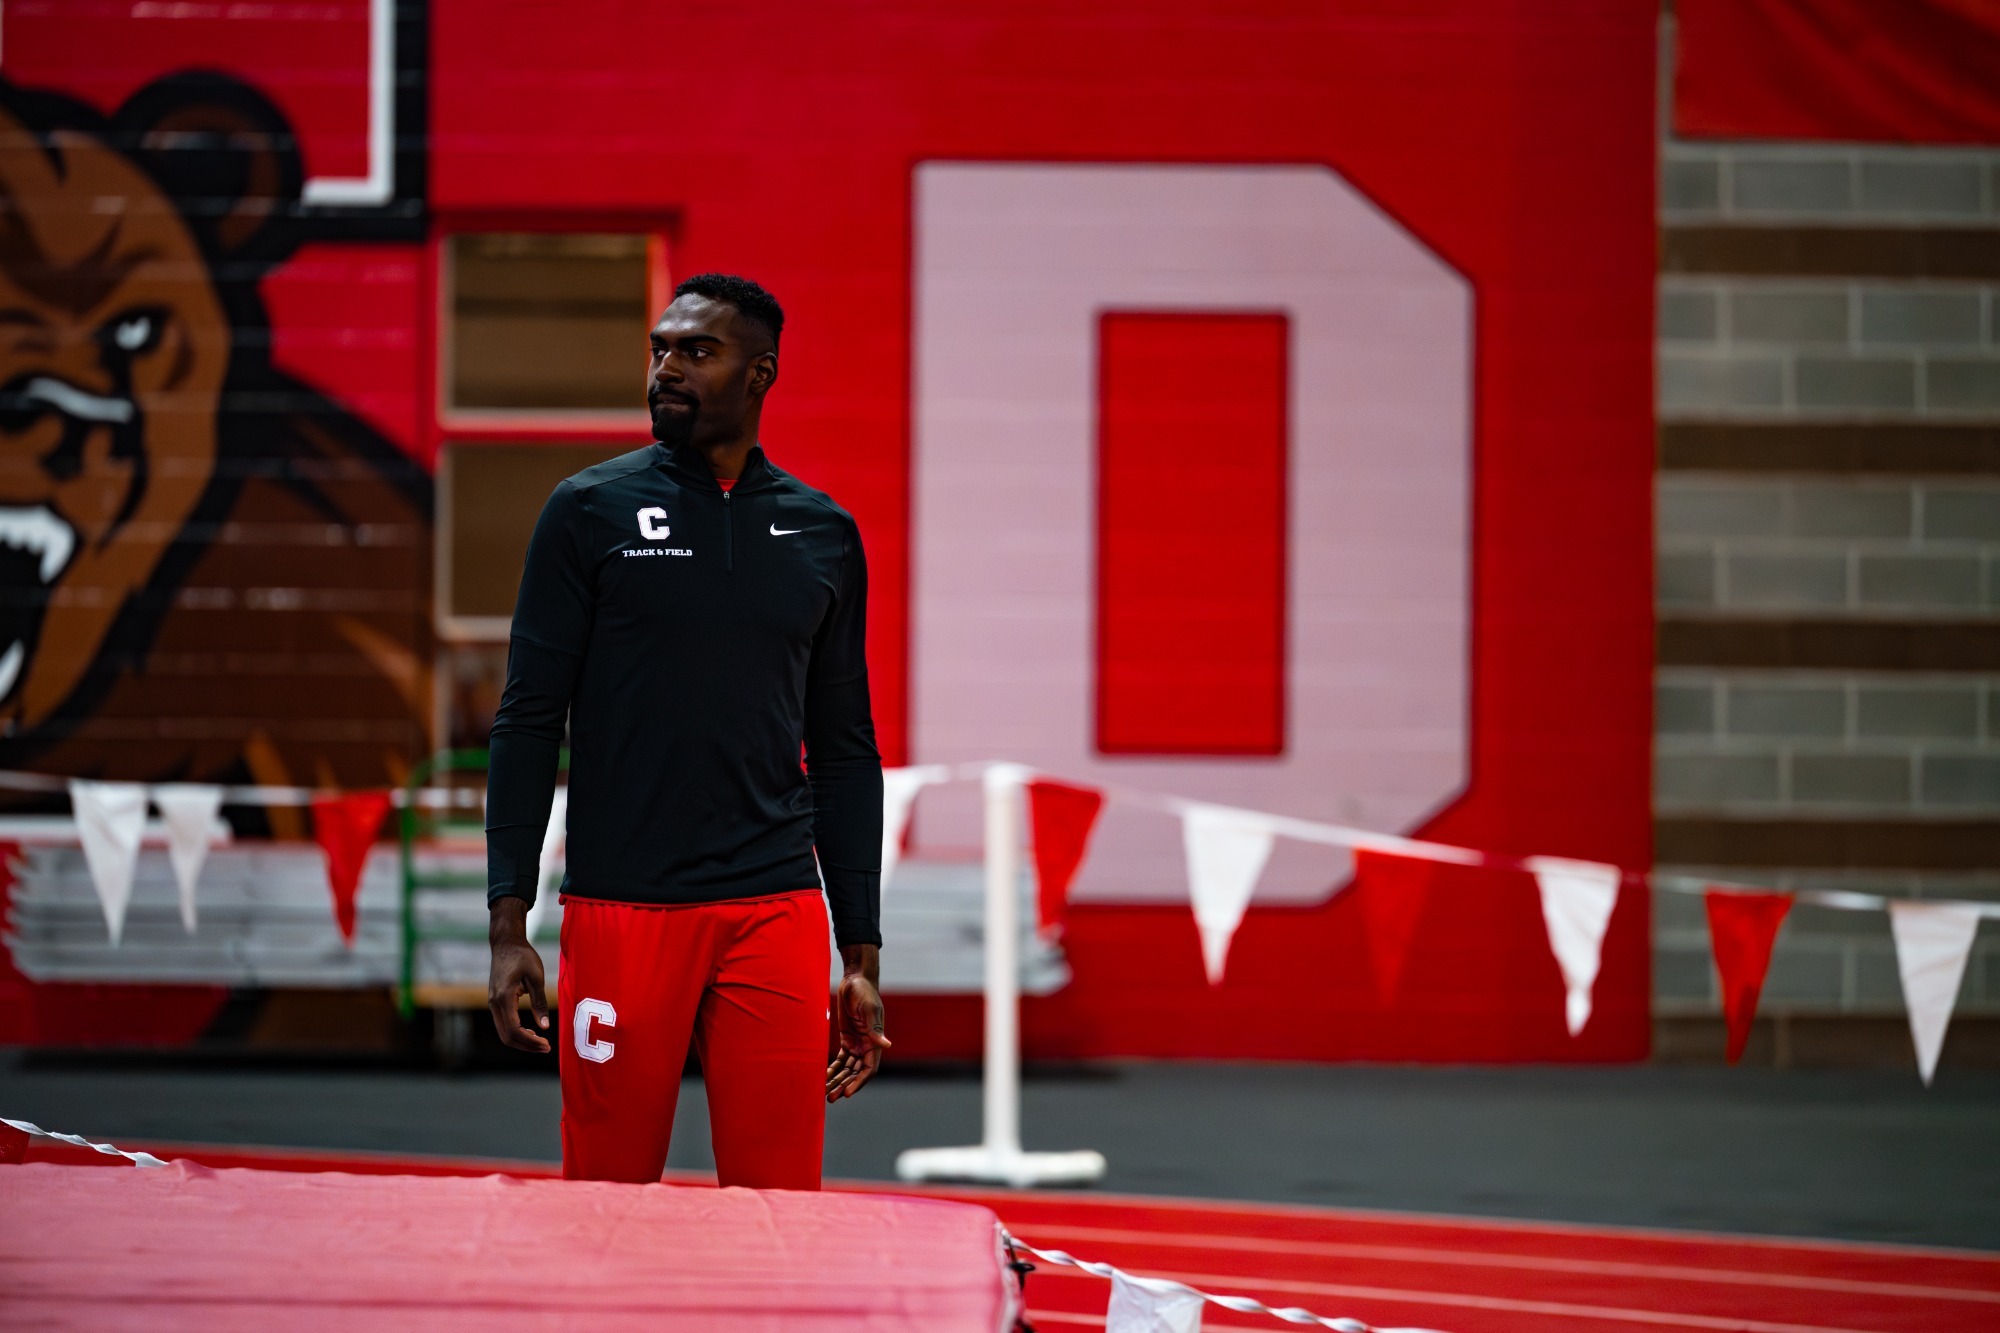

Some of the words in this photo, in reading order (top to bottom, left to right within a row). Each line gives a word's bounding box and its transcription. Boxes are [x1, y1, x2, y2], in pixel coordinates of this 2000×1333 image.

[637, 507, 670, 540] C
[622, 549, 656, 558] TRACK
[572, 997, 618, 1064] C
